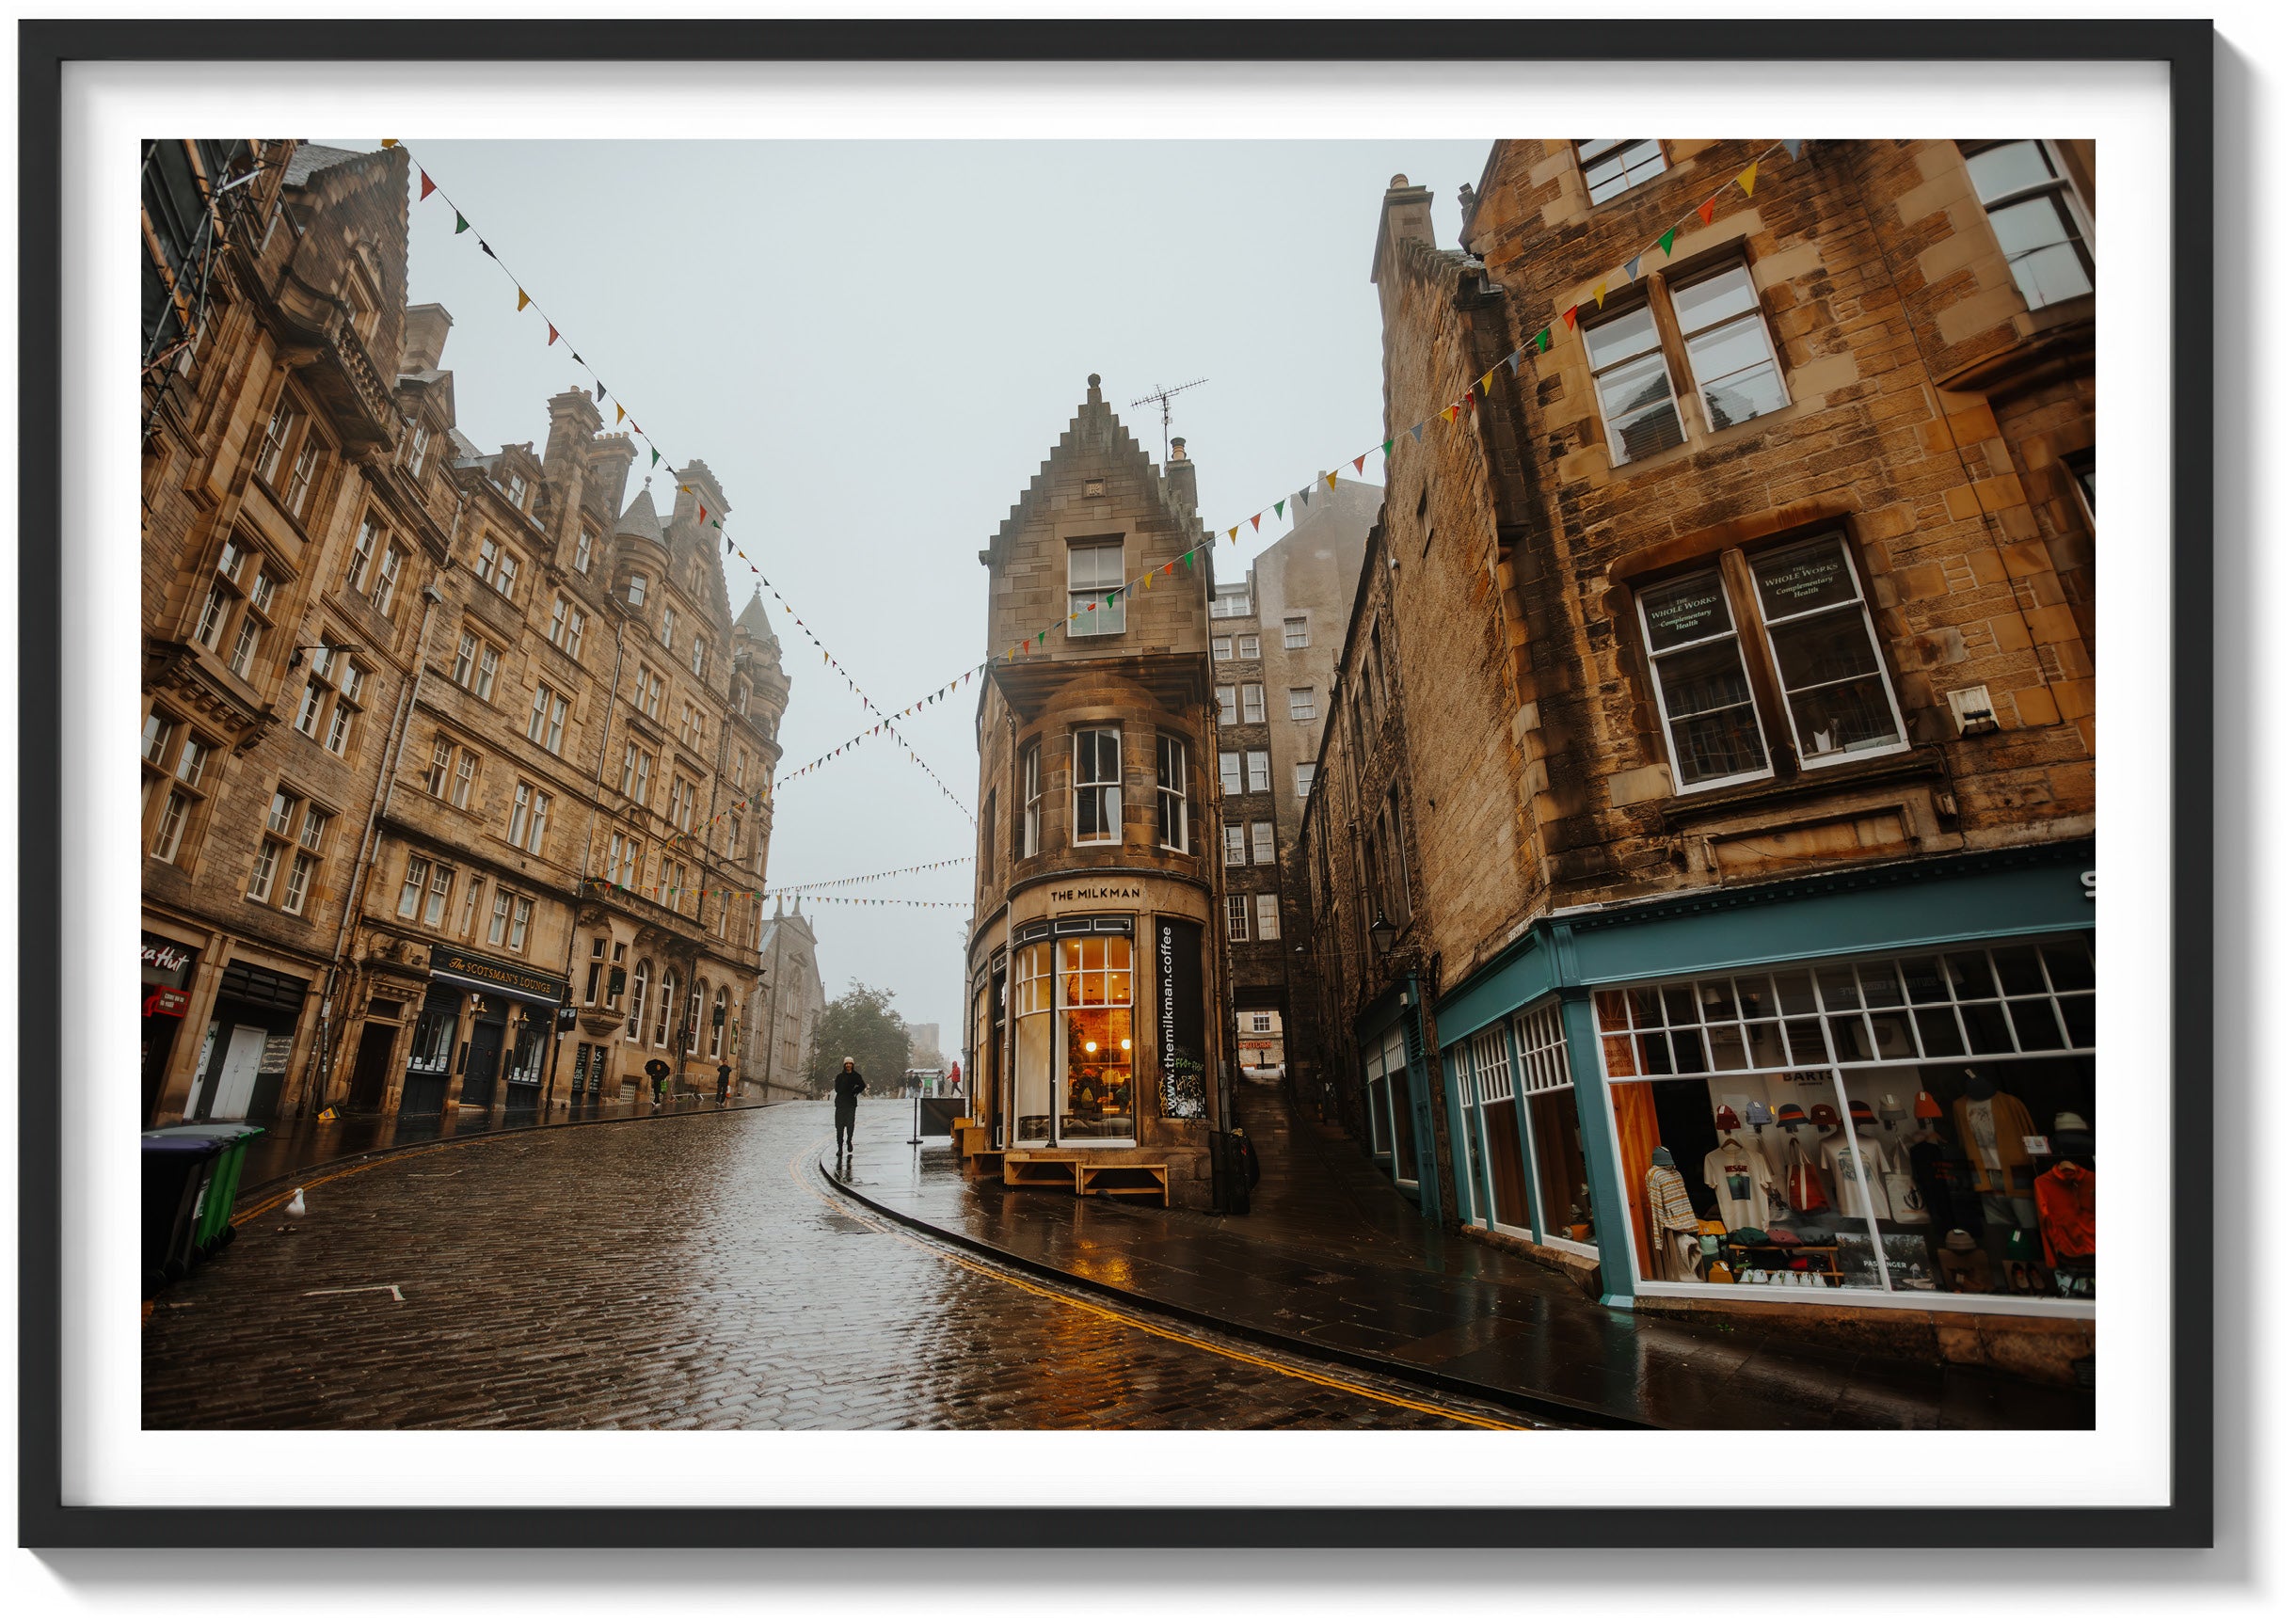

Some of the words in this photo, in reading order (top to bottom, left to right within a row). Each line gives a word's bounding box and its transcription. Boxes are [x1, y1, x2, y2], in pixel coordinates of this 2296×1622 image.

[1765, 572, 1800, 586] WHOLE
[1802, 563, 1839, 576] WORKS
[1776, 576, 1833, 595] Complementary
[1794, 586, 1819, 597] Health
[1651, 605, 1683, 619] WHOLE
[1684, 596, 1717, 609] WORKS
[1660, 609, 1712, 628] Complementary
[1676, 619, 1698, 630] Health
[1051, 890, 1073, 901] THE
[1077, 887, 1140, 898] MILKMAN
[154, 946, 189, 972] Hut
[449, 958, 466, 971] The
[466, 962, 518, 985] SCOTSMAN'S
[519, 978, 551, 994] LOUNGE
[1782, 1071, 1833, 1082] BARTS
[1863, 1260, 1906, 1268] PASNGER
